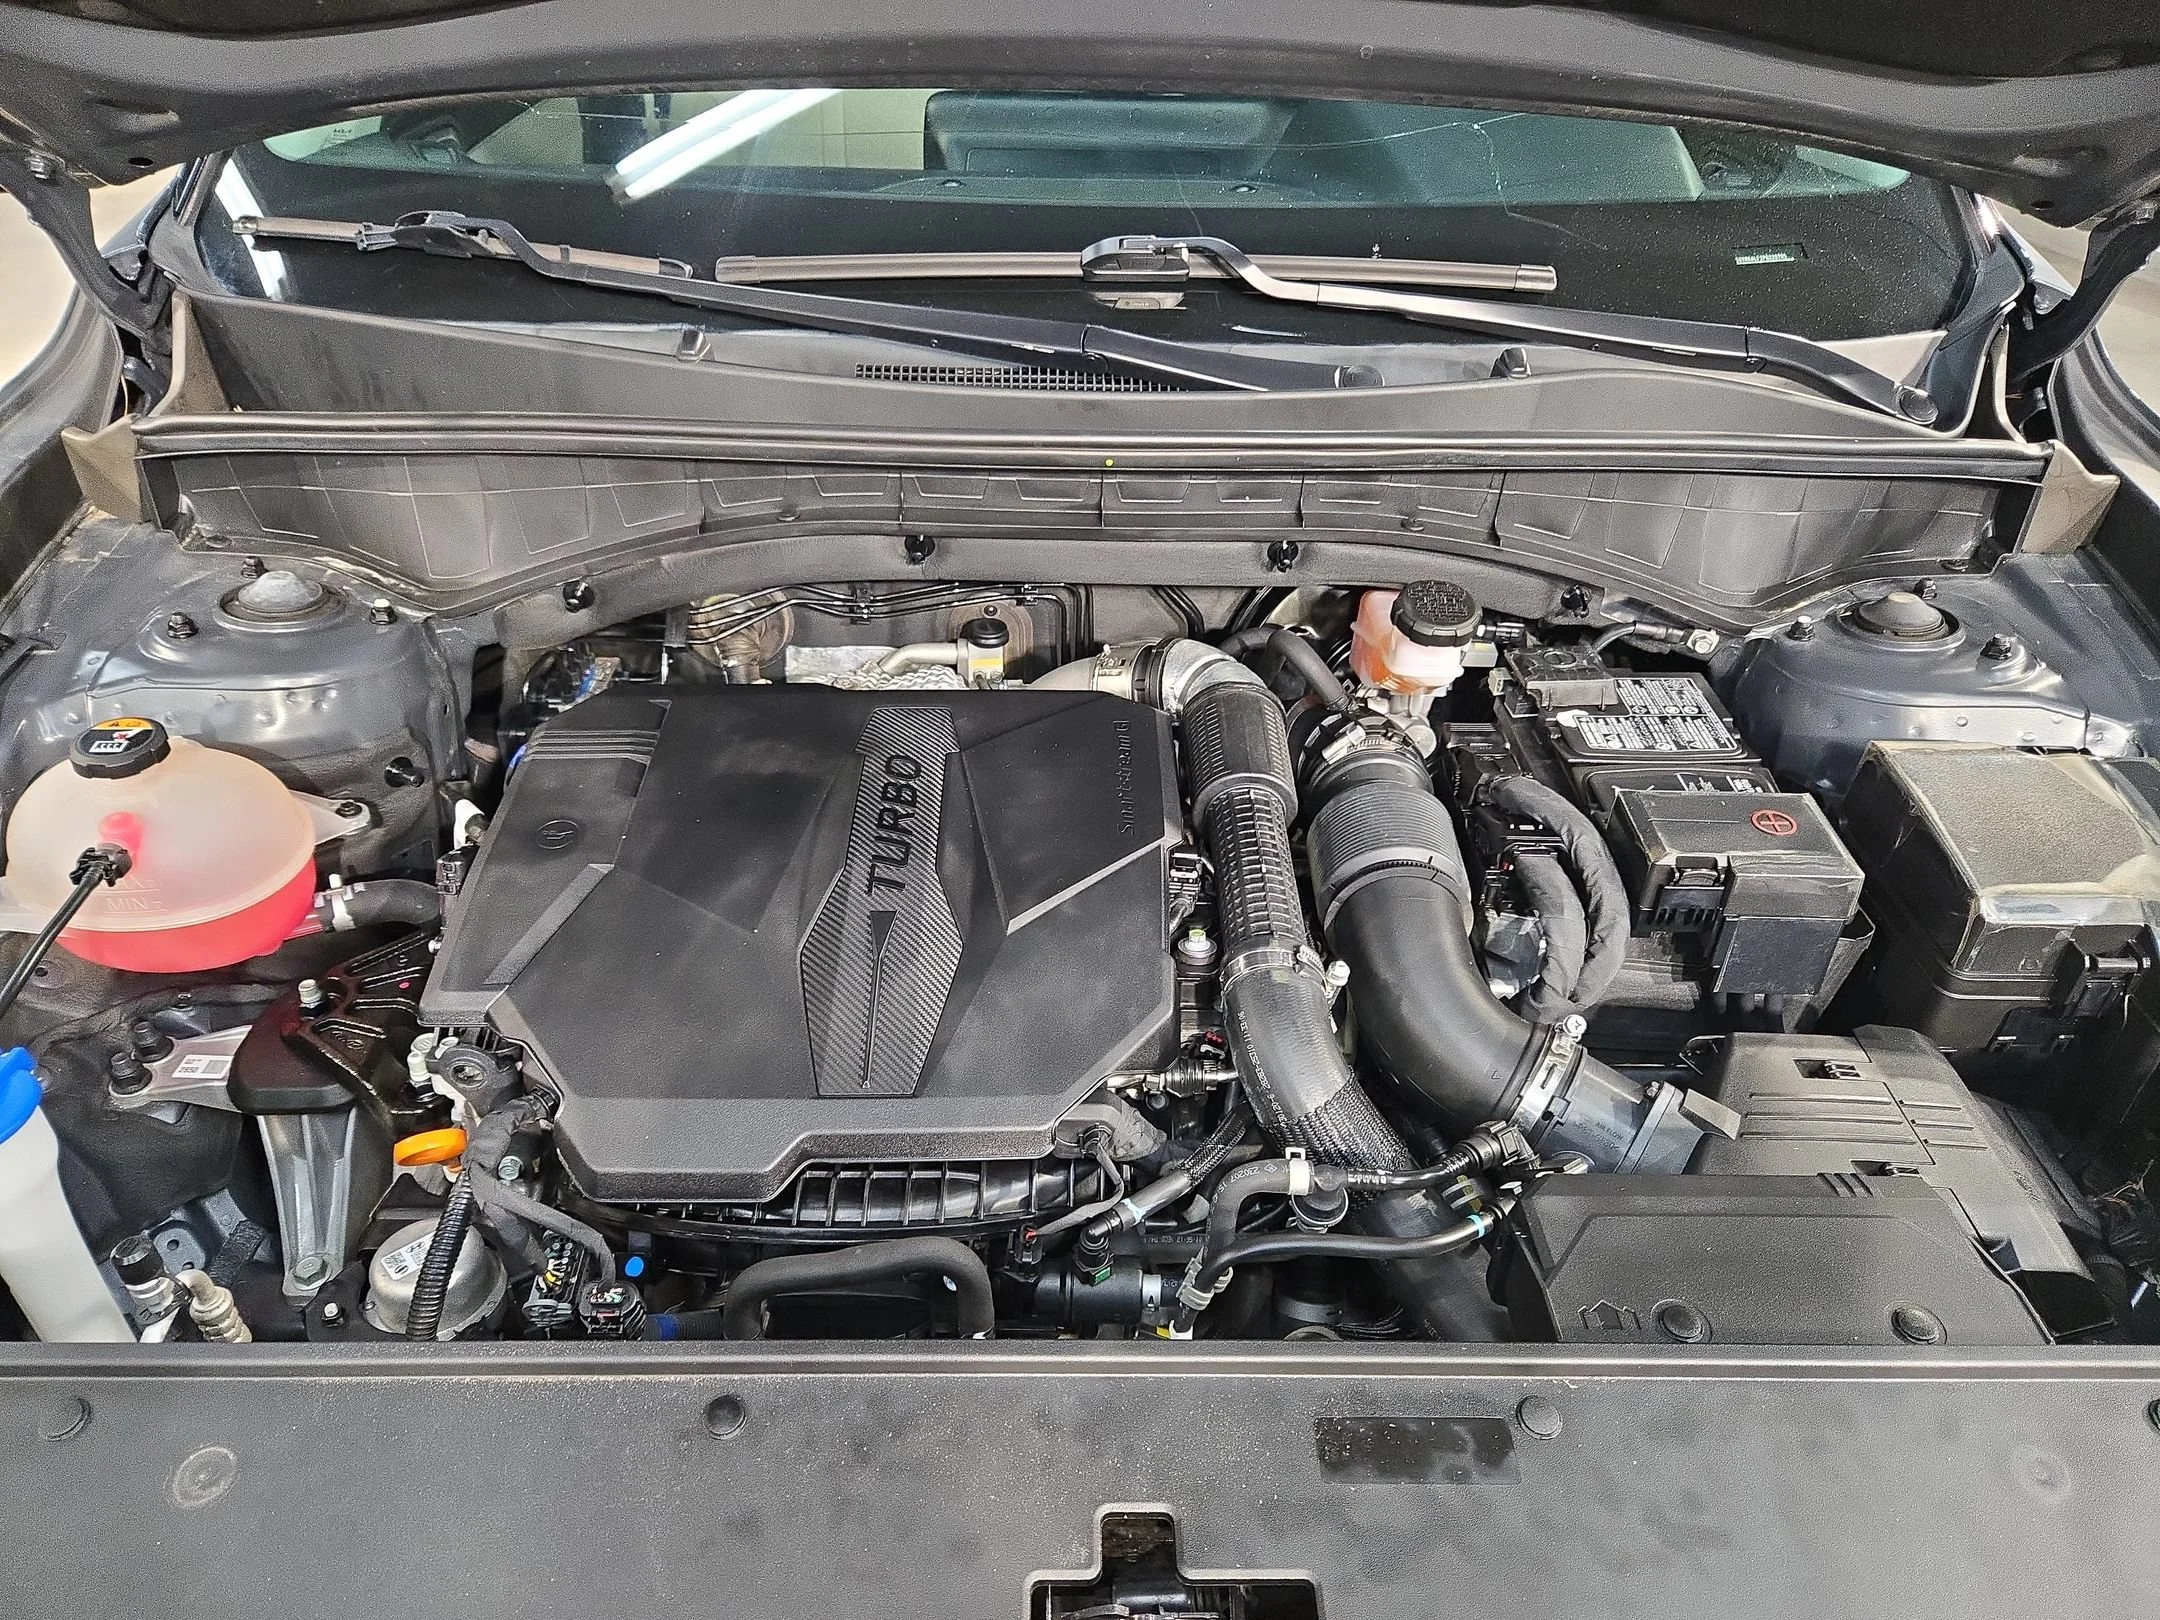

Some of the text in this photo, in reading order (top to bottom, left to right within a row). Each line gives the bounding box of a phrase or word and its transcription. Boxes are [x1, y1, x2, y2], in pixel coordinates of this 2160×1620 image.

[1115, 734, 1134, 836] Smartstream
[866, 754, 922, 896] TURBO
[1246, 1044, 1271, 1090] 28283-25310
[1230, 1166, 1260, 1183] 230207
